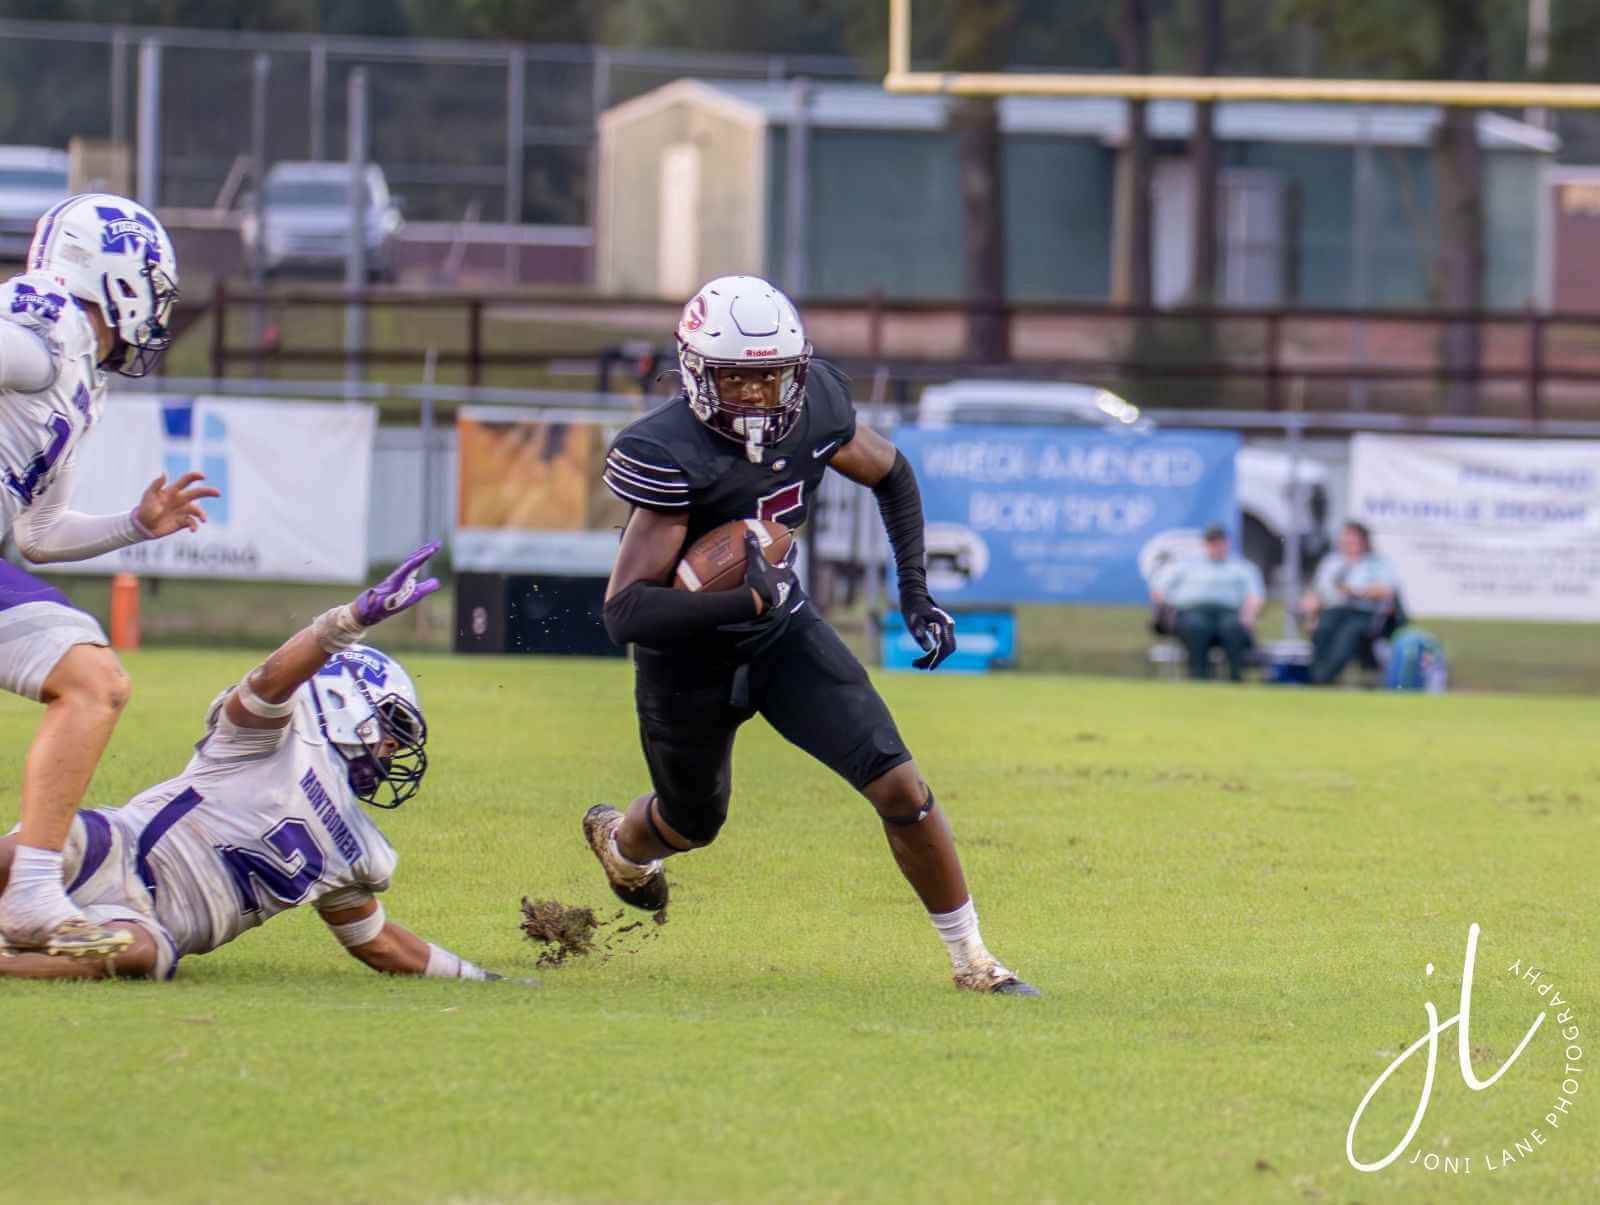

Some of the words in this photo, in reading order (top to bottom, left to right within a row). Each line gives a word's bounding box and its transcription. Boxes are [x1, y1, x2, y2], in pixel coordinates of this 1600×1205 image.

[743, 347, 778, 358] Riddell
[299, 766, 363, 865] MONTGOMERY
[213, 816, 326, 916] 2
